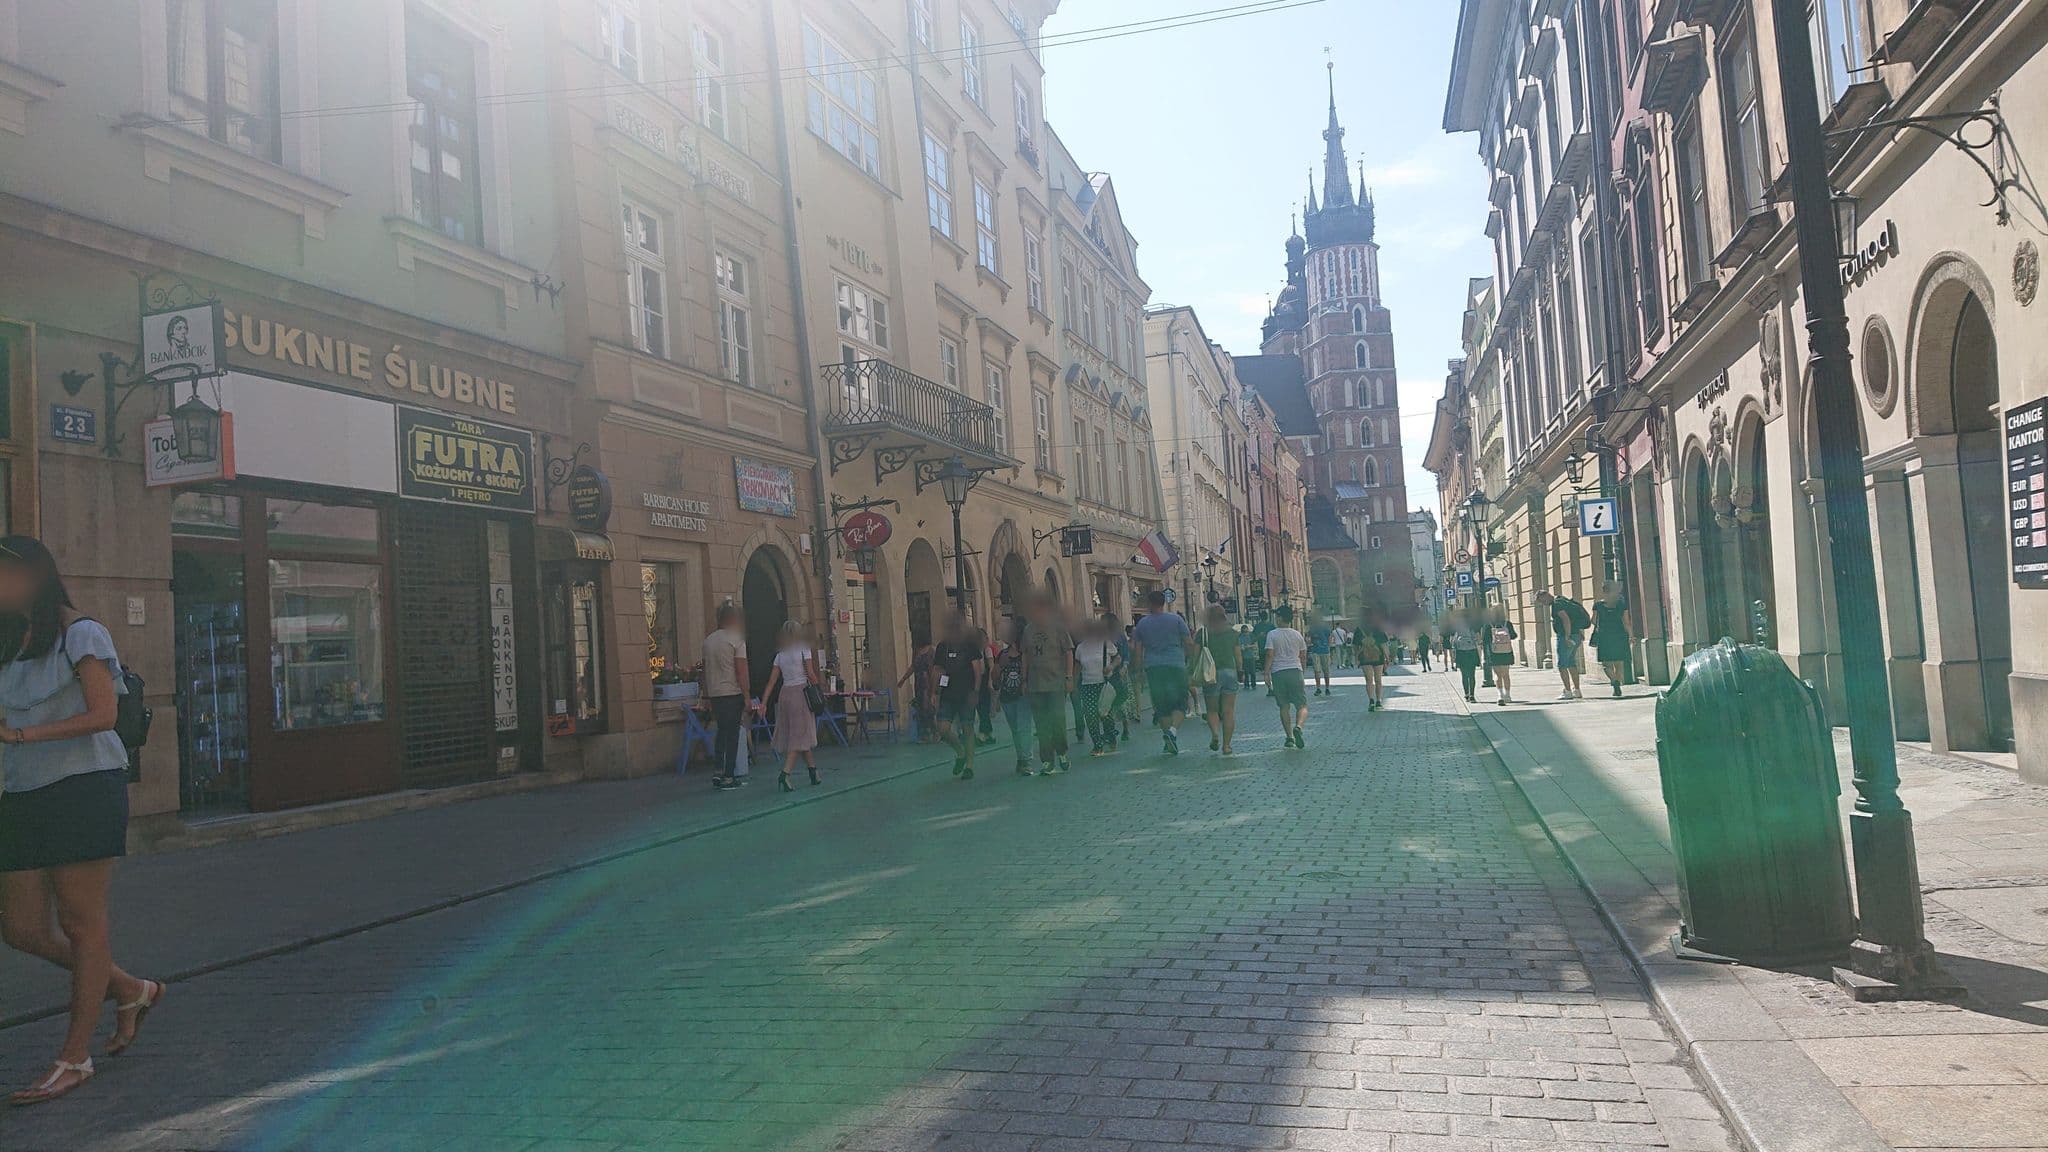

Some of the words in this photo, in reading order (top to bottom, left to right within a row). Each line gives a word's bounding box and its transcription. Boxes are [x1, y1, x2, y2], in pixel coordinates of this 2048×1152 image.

[1839, 219, 1892, 286] romod
[223, 308, 373, 381] SUKNIE
[384, 345, 517, 415] ŚLUBNE
[64, 415, 85, 433] 23
[455, 420, 482, 435] TARA
[2008, 406, 2043, 430] CHANGE
[2008, 427, 2044, 451] KANTOR
[415, 430, 521, 476] FUTRA
[416, 462, 475, 482] KOŻUCHY
[484, 473, 521, 490] SKÓRY
[457, 488, 491, 501] PIĘTRO
[2012, 479, 2027, 493] EUR
[643, 492, 684, 511] BARBICAN
[2013, 498, 2028, 511] USD
[650, 512, 707, 532] APARTMENTS
[2014, 517, 2029, 530] GBP
[2015, 535, 2030, 548] CHF
[580, 549, 611, 560] TARA
[490, 626, 502, 700] MONETY
[503, 614, 514, 710] BANKNOTY
[495, 716, 516, 729] SKUP
